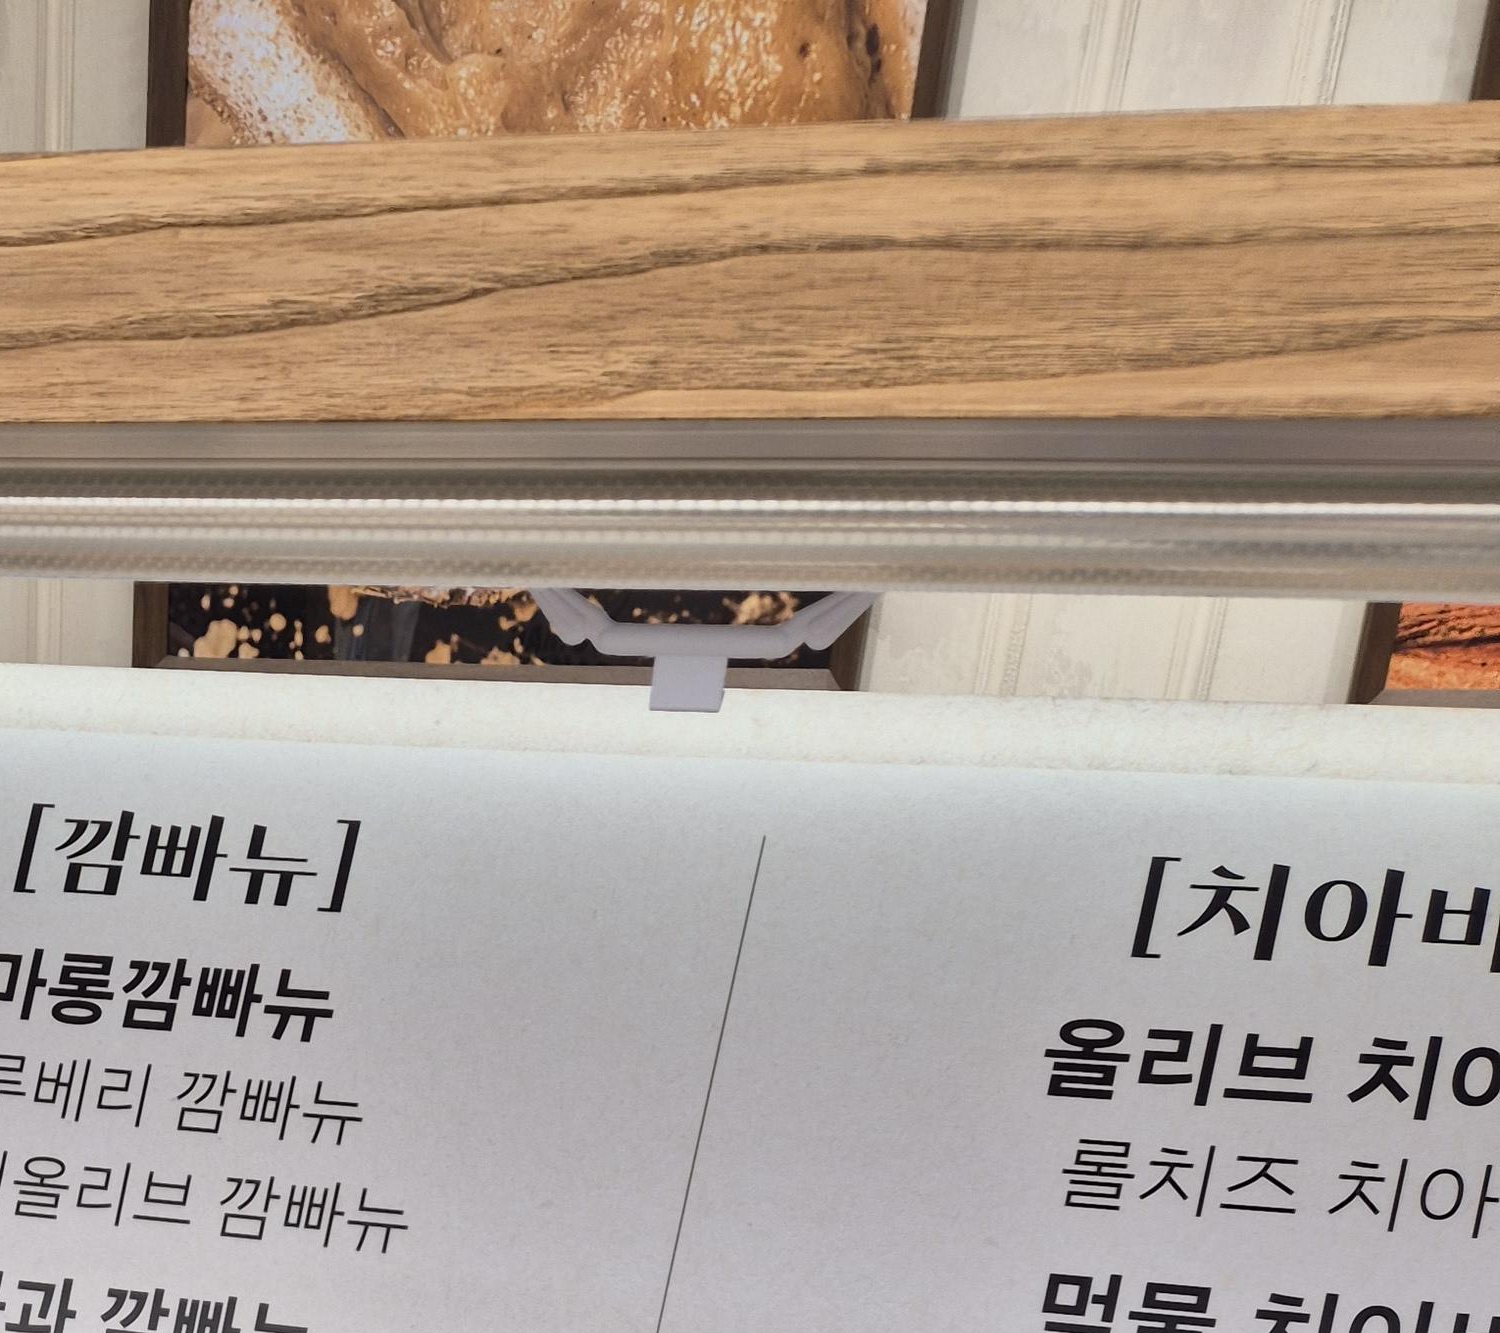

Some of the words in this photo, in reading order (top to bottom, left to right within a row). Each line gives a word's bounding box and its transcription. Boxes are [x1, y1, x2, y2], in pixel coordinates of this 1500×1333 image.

[13, 803, 361, 913] [깜빠뉴]
[1044, 1019, 1313, 1106] 올리브
[177, 1071, 362, 1145] 깜빠뉴
[220, 1176, 408, 1253] 깜빠뉴
[1062, 1139, 1298, 1217] 롤치즈
